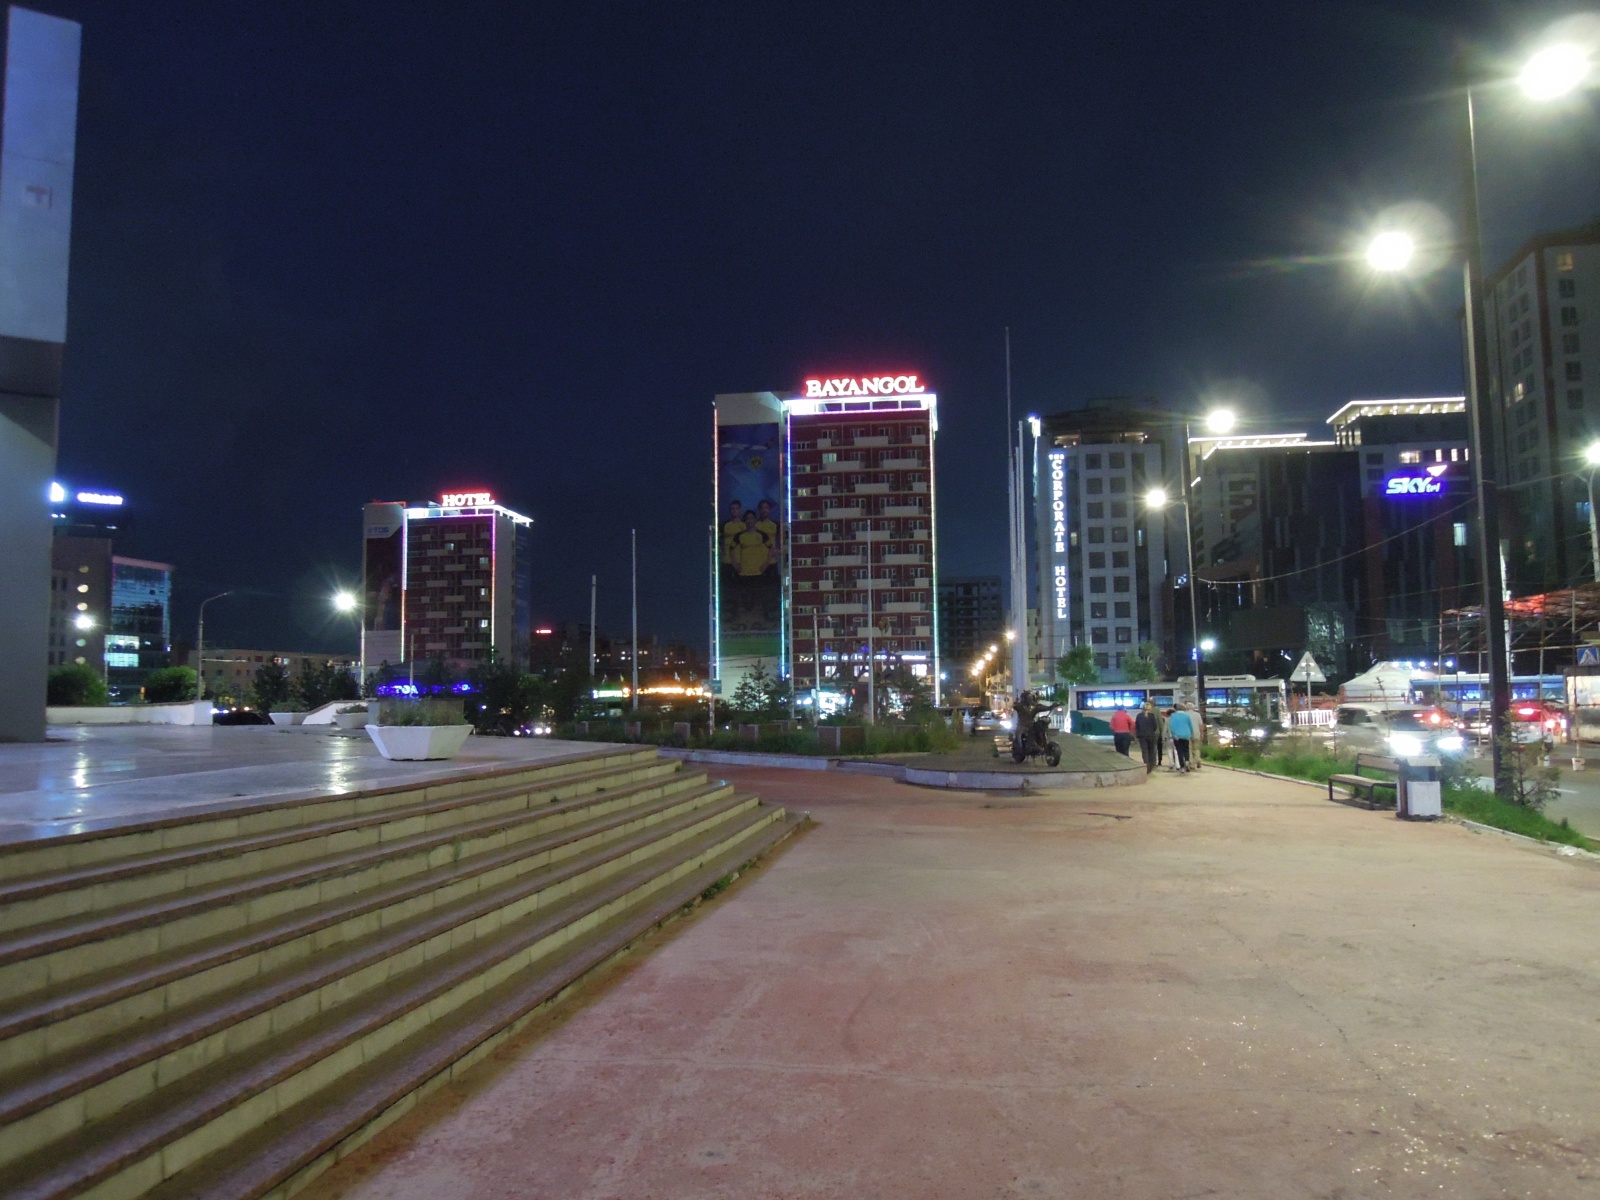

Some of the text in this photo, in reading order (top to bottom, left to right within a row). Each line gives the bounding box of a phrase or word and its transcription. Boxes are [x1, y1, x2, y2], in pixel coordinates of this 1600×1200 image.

[805, 376, 925, 397] BAYANGOL
[442, 493, 495, 507] HOTEL
[1052, 460, 1067, 619] CORPORATE HOTEL
